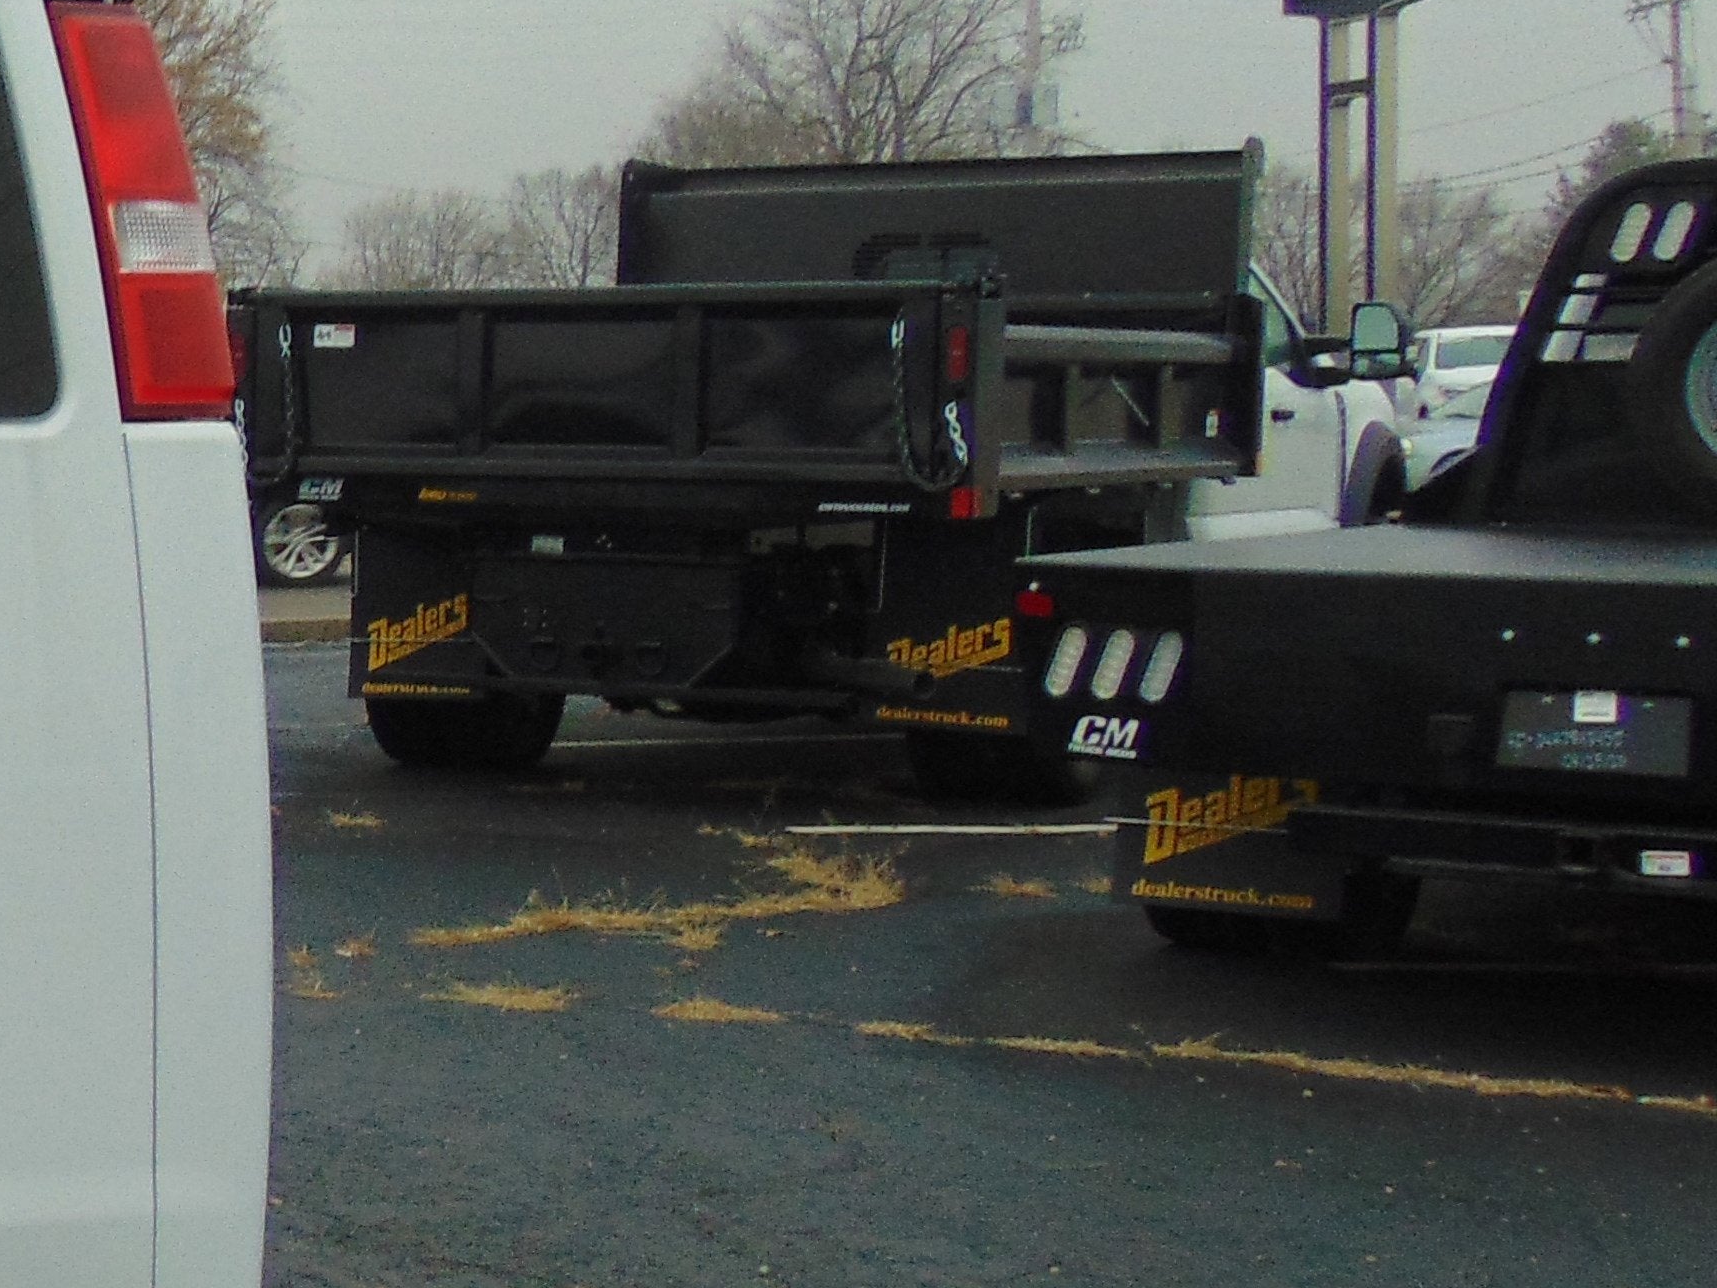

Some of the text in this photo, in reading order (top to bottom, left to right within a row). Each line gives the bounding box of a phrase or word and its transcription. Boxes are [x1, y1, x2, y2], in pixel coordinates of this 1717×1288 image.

[367, 593, 469, 672] Dealers
[1072, 715, 1140, 748] CM
[1131, 878, 1316, 908] dealerstruck.com
